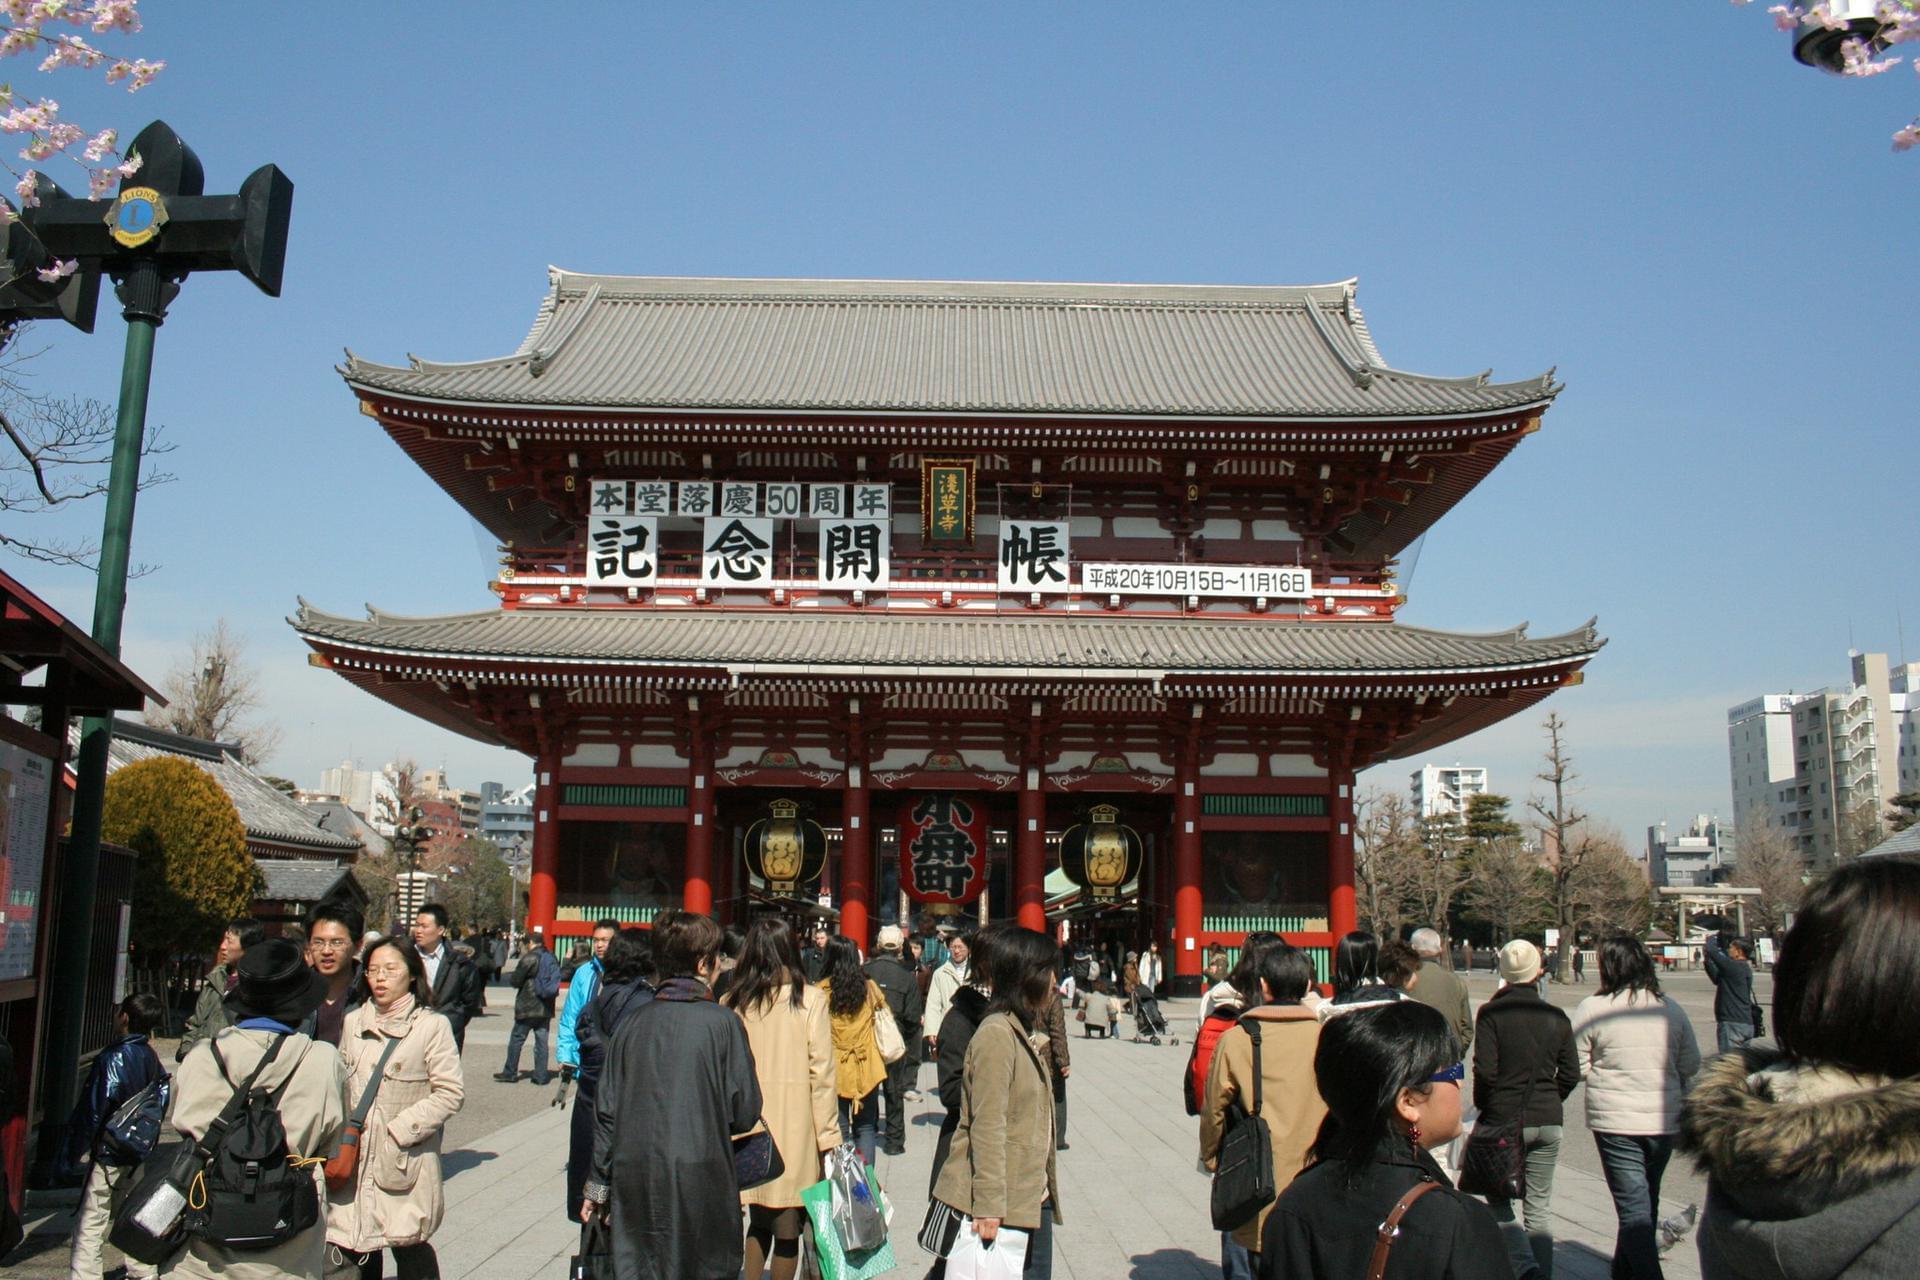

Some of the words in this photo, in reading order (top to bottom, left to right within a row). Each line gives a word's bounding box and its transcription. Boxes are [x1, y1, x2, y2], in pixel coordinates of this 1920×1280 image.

[124, 189, 156, 201] LIONS
[592, 483, 888, 516] 本堂落慶50周年
[909, 796, 977, 899] 小舟町
